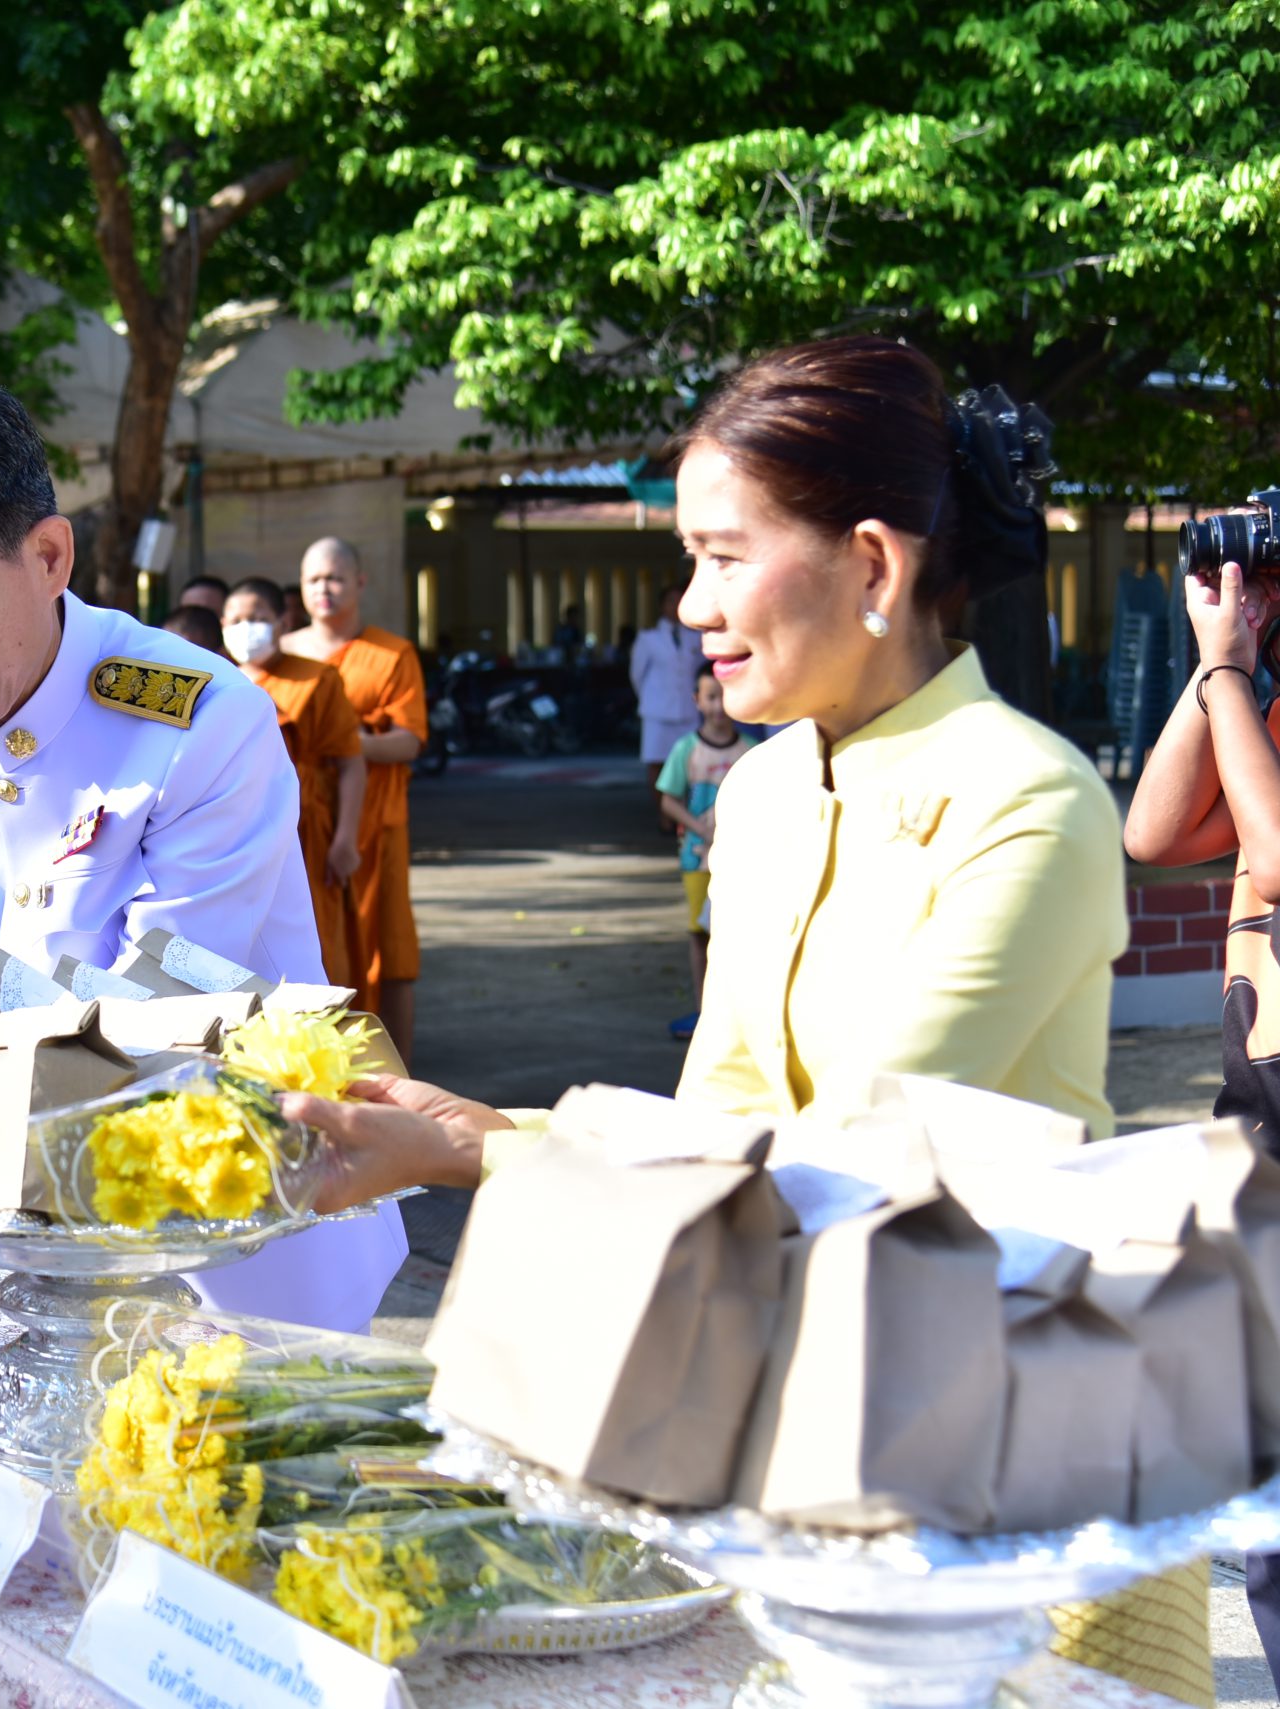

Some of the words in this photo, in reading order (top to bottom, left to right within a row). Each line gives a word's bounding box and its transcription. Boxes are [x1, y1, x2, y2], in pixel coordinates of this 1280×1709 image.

[143, 1590, 325, 1708] ประธานแม่บ้านมหาดไทย
